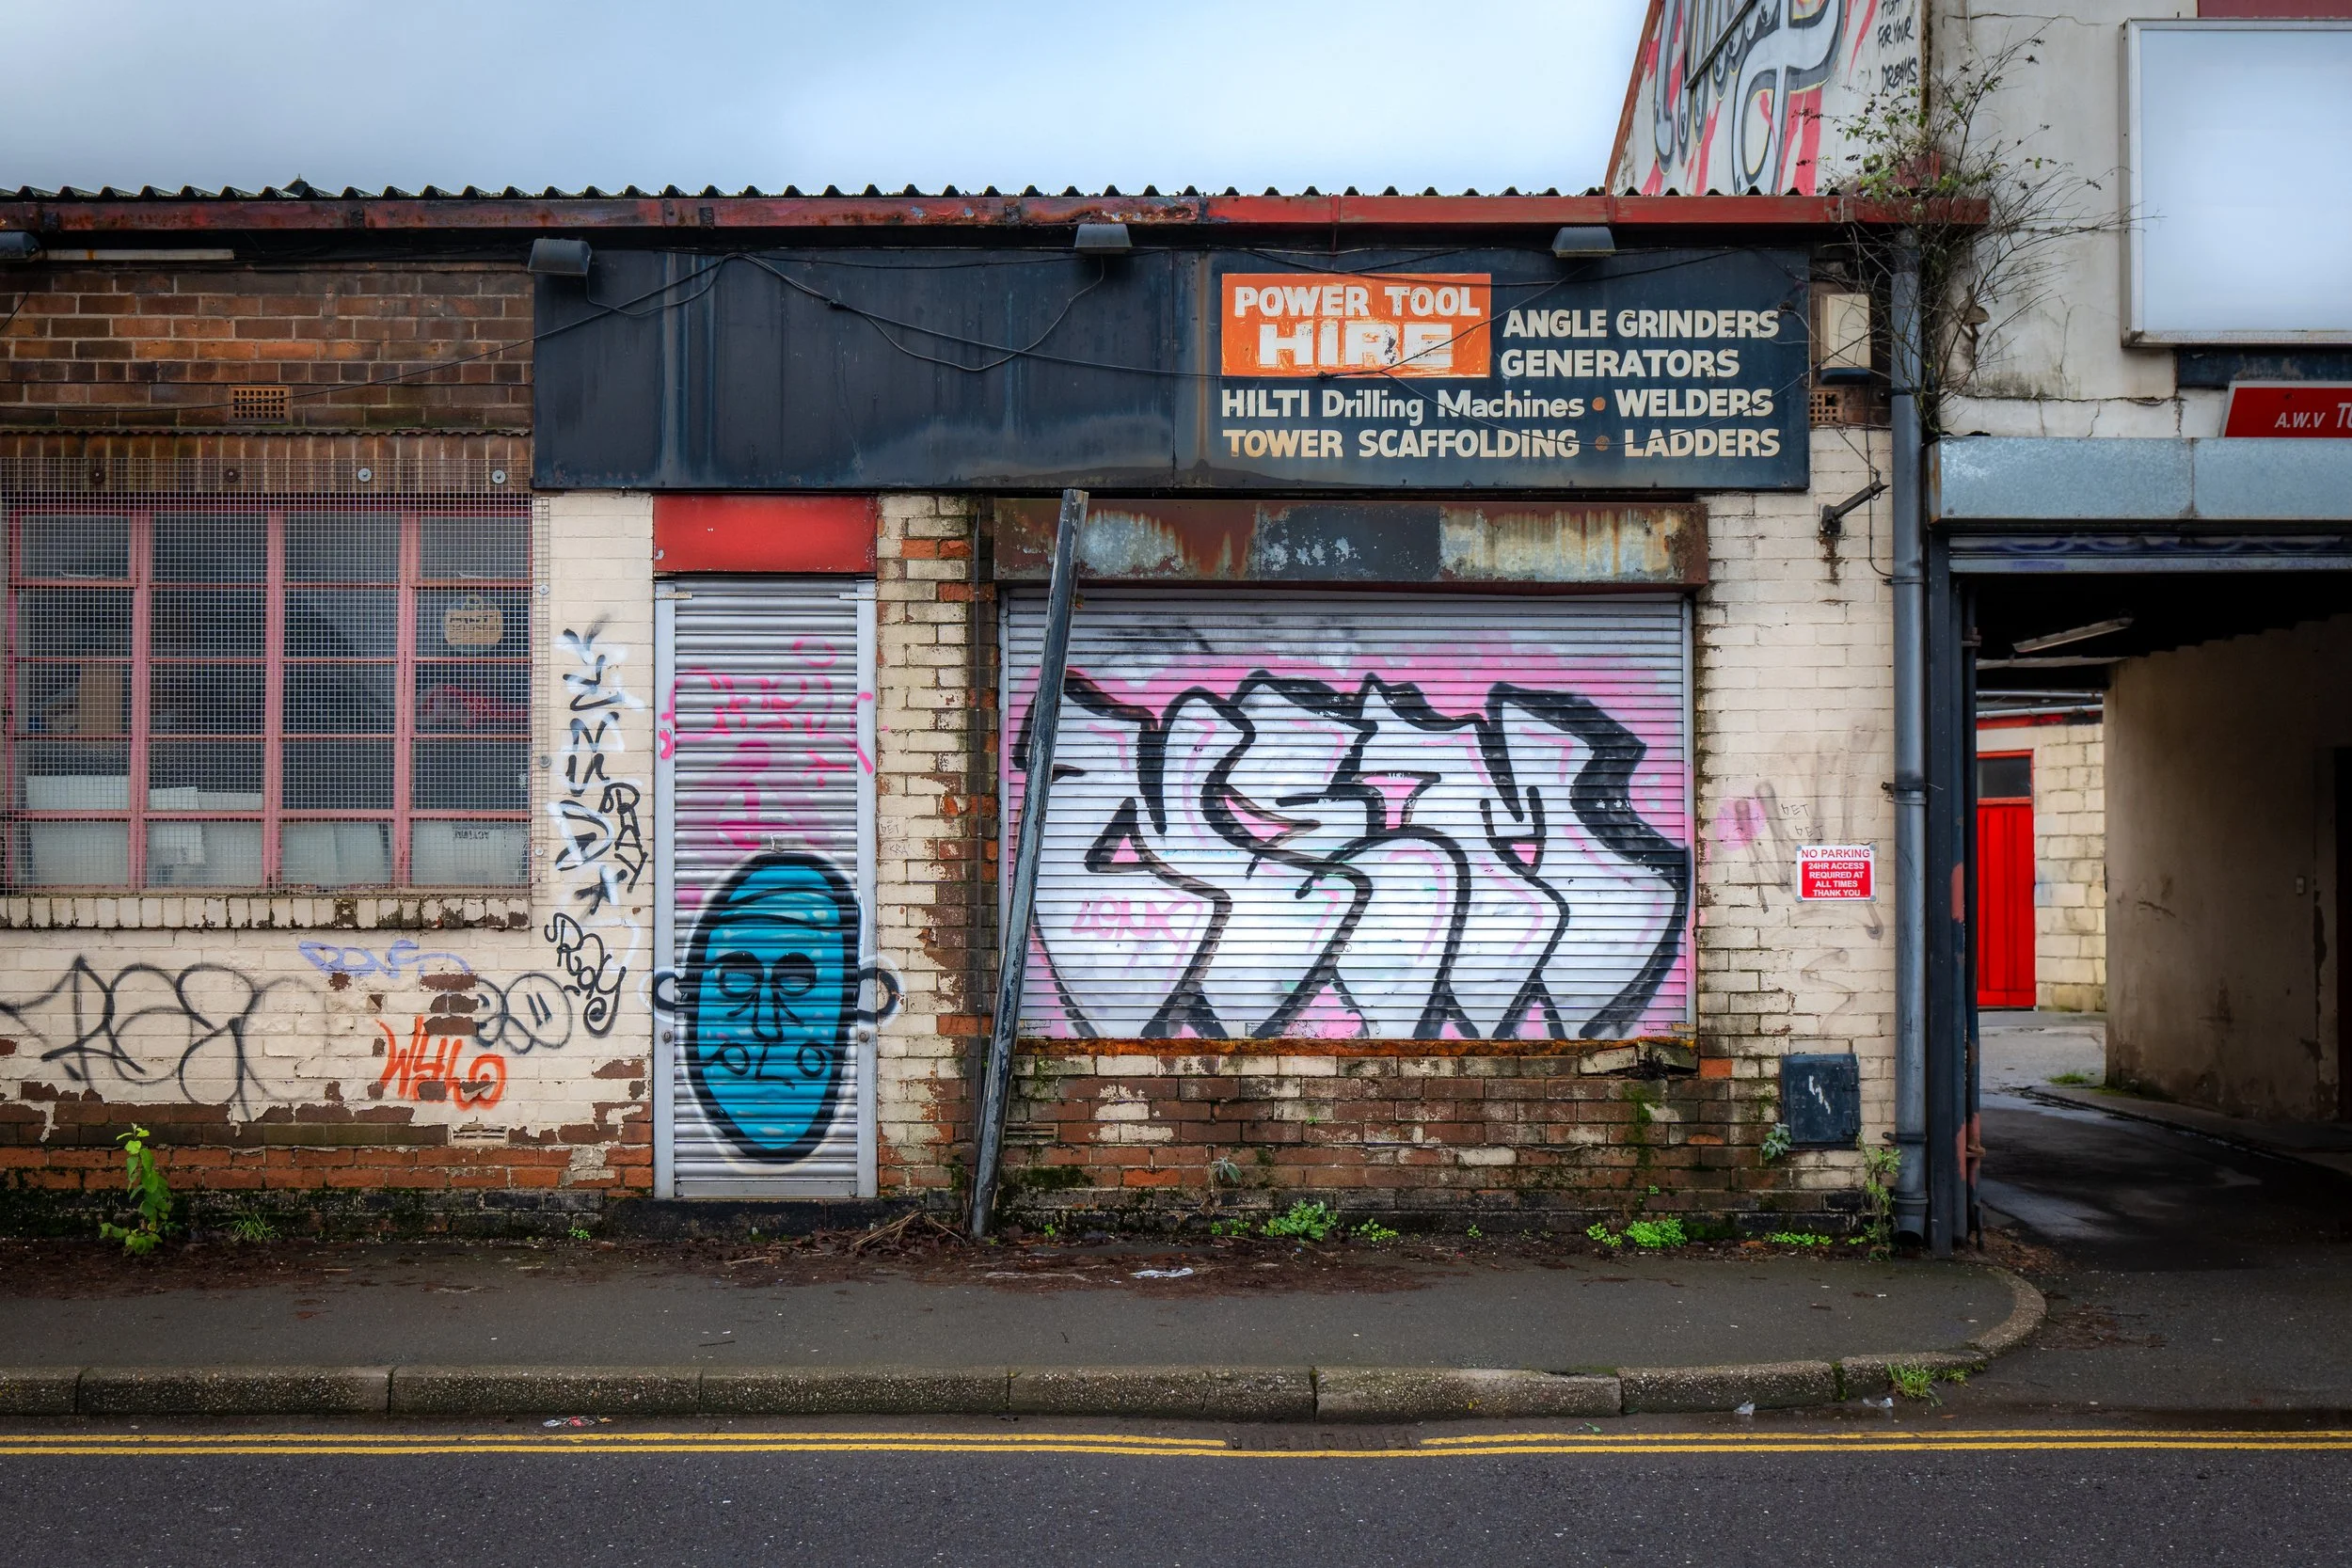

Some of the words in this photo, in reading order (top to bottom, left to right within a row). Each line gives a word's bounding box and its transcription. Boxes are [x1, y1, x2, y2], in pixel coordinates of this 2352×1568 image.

[1877, 24, 1893, 49] FOR
[1893, 15, 1915, 45] YOUR
[1234, 286, 1371, 317] POWER
[1385, 286, 1482, 317] TOOL
[1502, 309, 1607, 338] ANGLE
[1615, 309, 1780, 339] GRINDERS
[1259, 323, 1454, 368] HIRE
[1501, 349, 1740, 378] GENERATORS
[1222, 389, 1310, 418] HILTI
[1322, 389, 1423, 426] Drilling
[1438, 389, 1585, 418] Machines
[1614, 388, 1774, 418] WELDERS
[2274, 411, 2326, 429] A.W.V
[1223, 429, 1343, 457] TOWER
[1359, 429, 1581, 458] SCAFFOLDING
[1624, 429, 1780, 457] LADDERS
[1802, 849, 1818, 858] NO
[1821, 849, 1870, 858] PARKING
